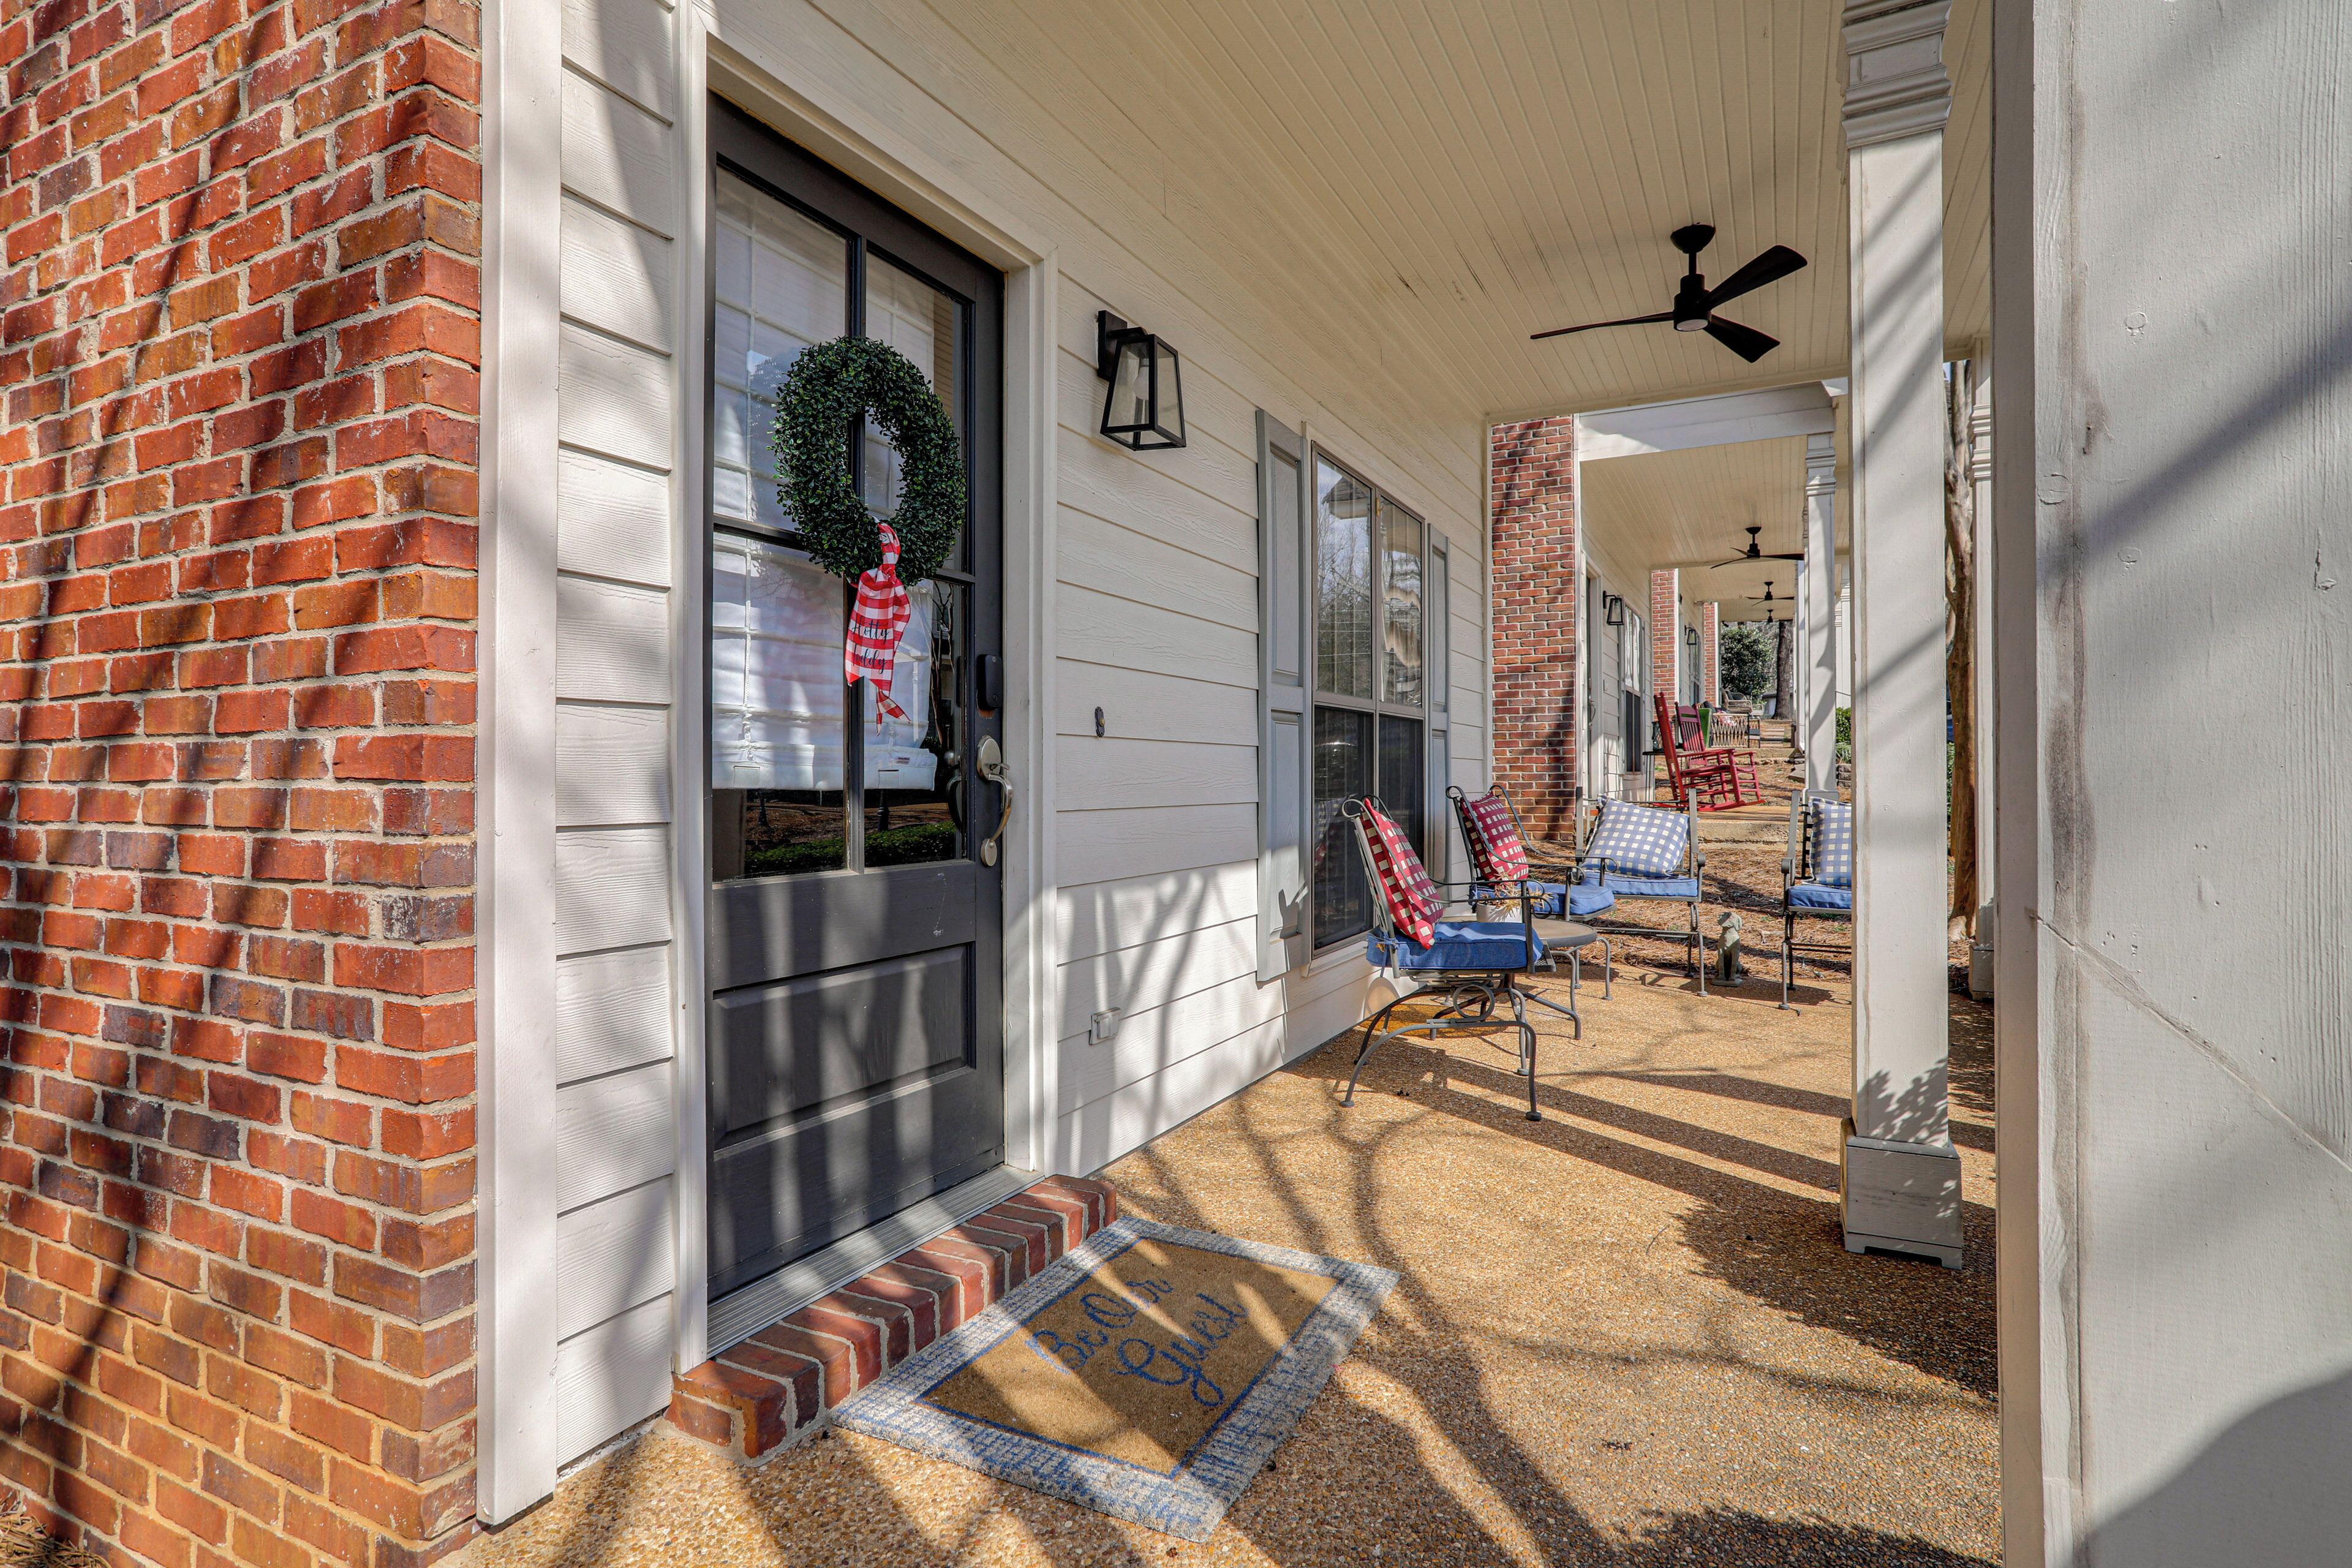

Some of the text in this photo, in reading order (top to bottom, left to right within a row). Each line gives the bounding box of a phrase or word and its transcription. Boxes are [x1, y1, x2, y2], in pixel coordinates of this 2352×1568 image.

[852, 613, 889, 645] Hotty
[1025, 1279, 1174, 1375] Be Our
[1110, 1293, 1248, 1407] Guest
